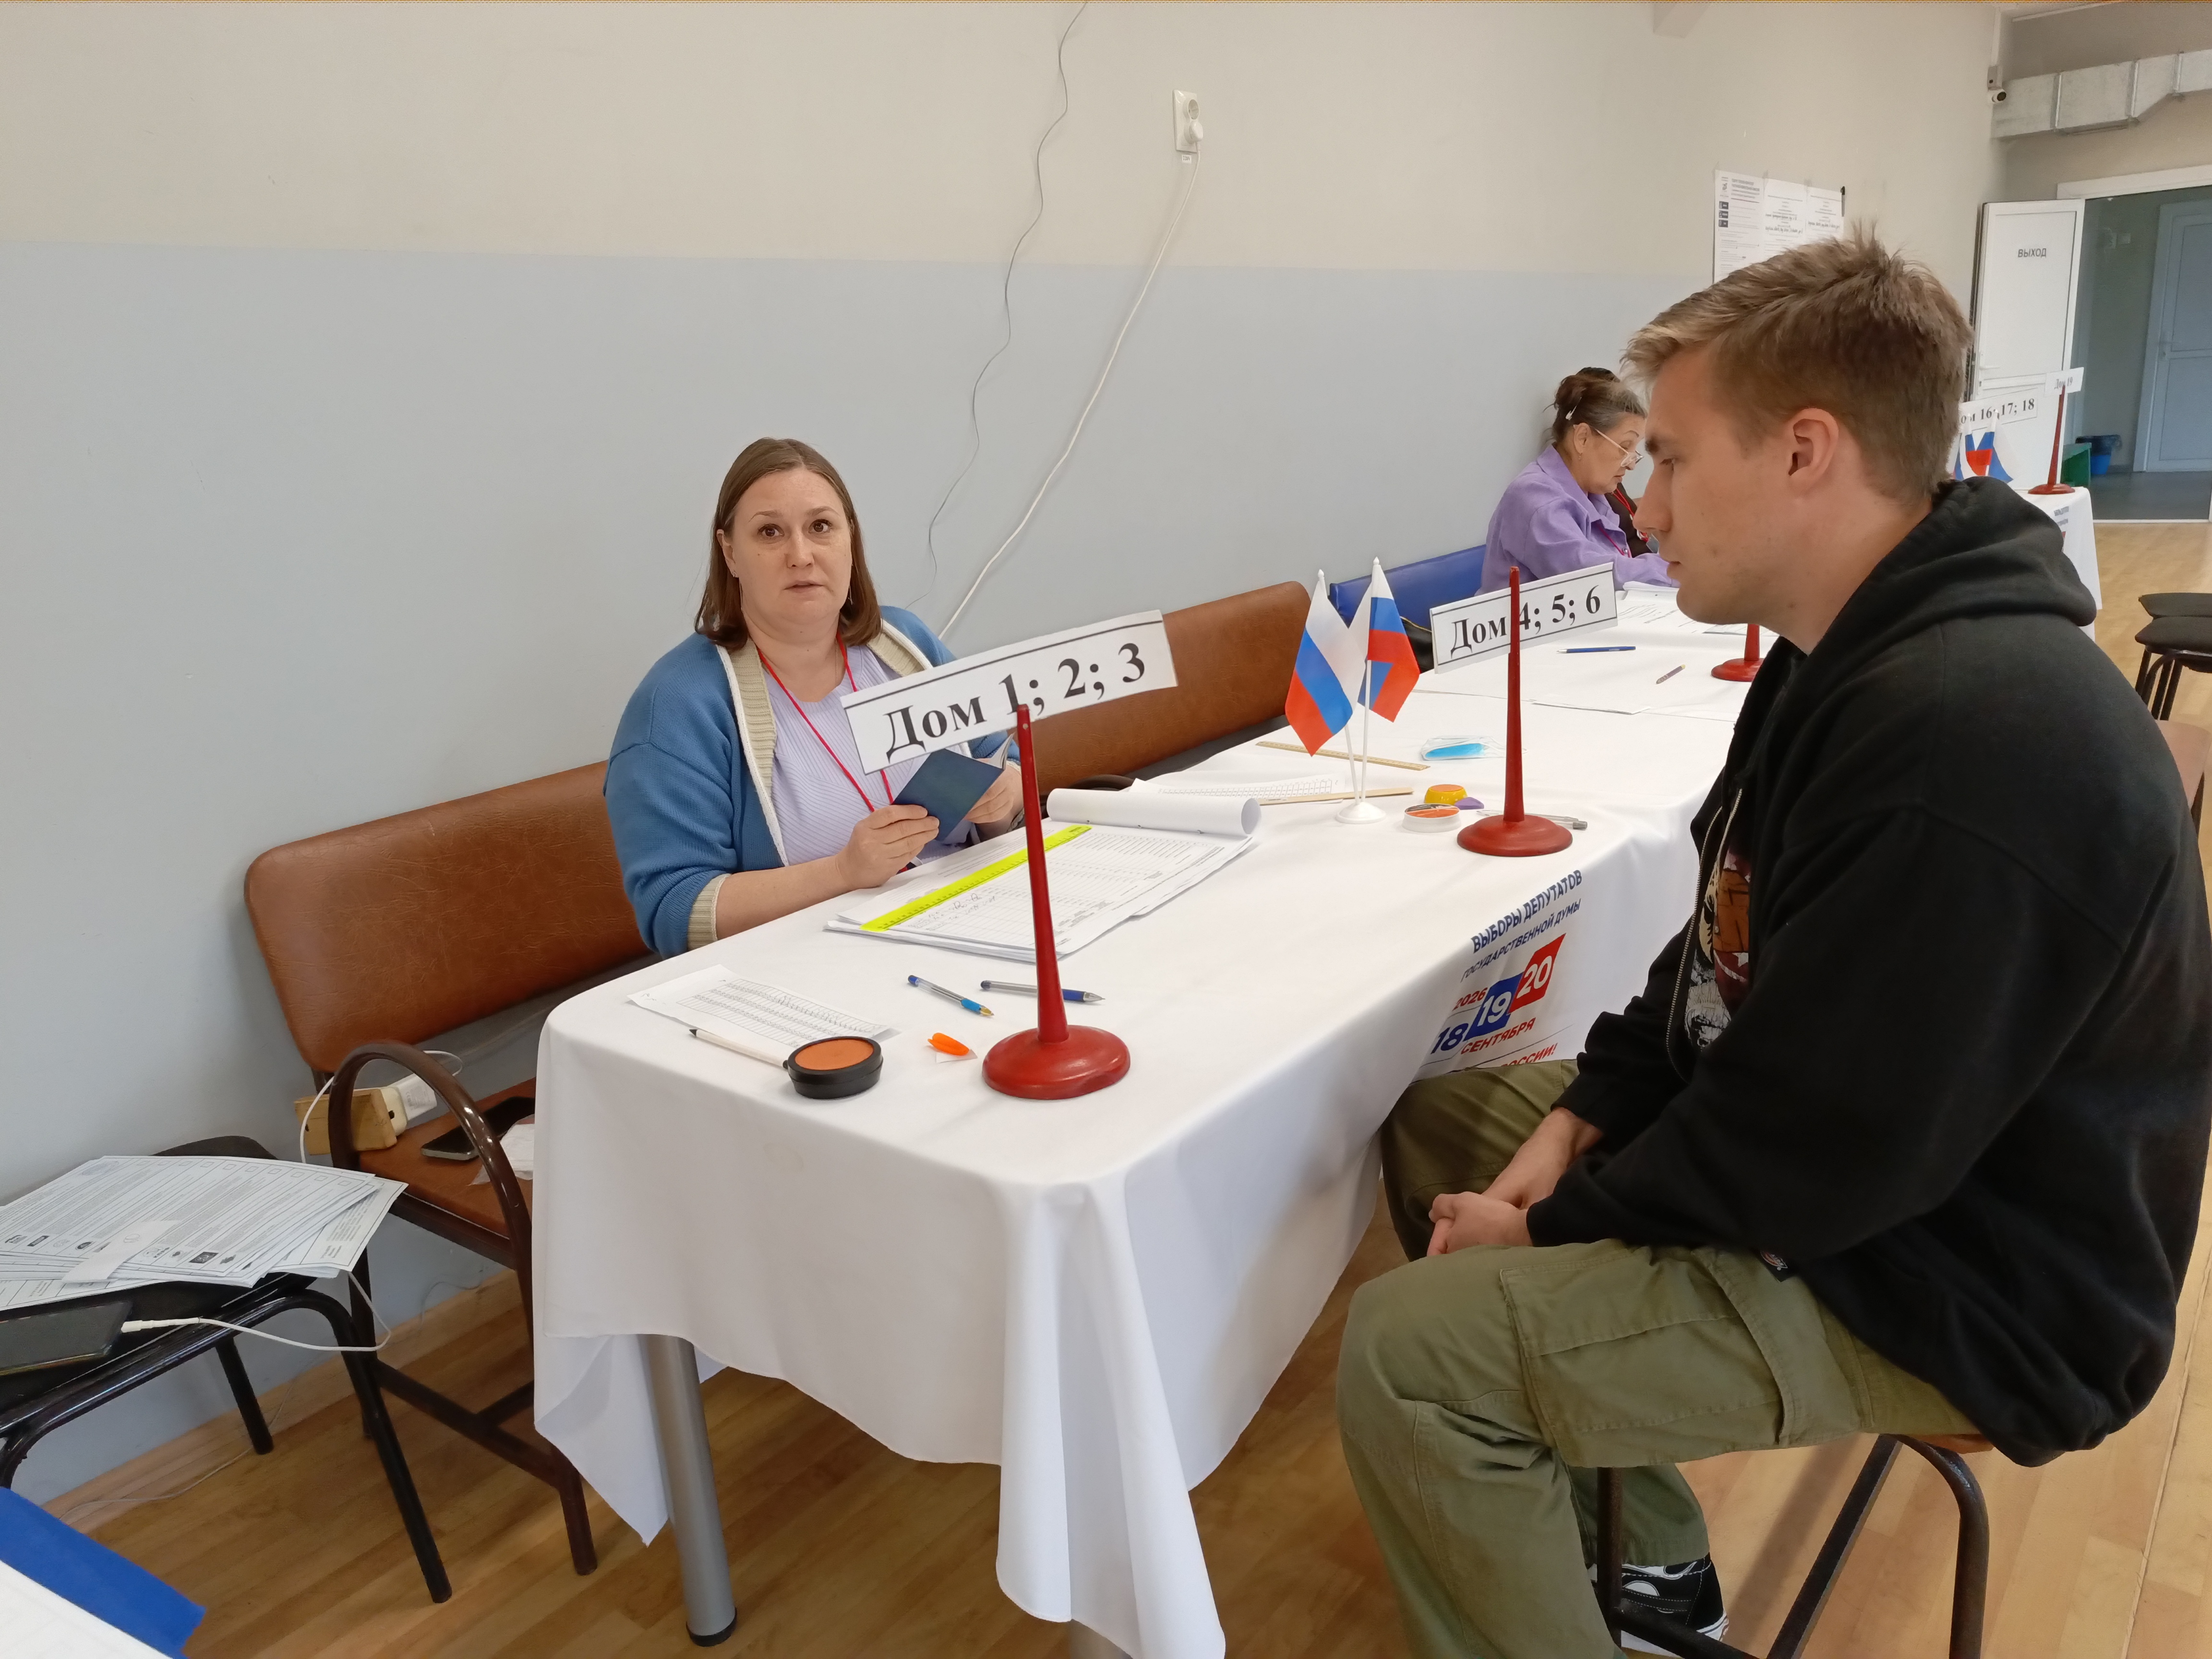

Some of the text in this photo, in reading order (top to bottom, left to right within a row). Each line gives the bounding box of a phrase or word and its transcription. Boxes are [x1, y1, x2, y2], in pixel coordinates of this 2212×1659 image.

[2018, 248, 2046, 258] ВЫХОД
[2067, 376, 2073, 387] 19
[2001, 402, 2017, 416] 17;
[2023, 398, 2035, 411] 18
[1450, 585, 1601, 659] Дом 4; 5; 6
[882, 642, 1145, 763] Дом 1; 2; 3
[1470, 870, 1582, 954] ВЫБОРЫ ДЕПУТАТОВ
[1460, 898, 1581, 983] ГОСУДАРСТВЕННОЙ ДУМЫ
[1430, 955, 1552, 1055] 18 19 20
[1452, 987, 1488, 1012] 2026
[1460, 1017, 1536, 1055] СЕНТЯБРЯ
[1501, 1043, 1558, 1066] ССИИ!
